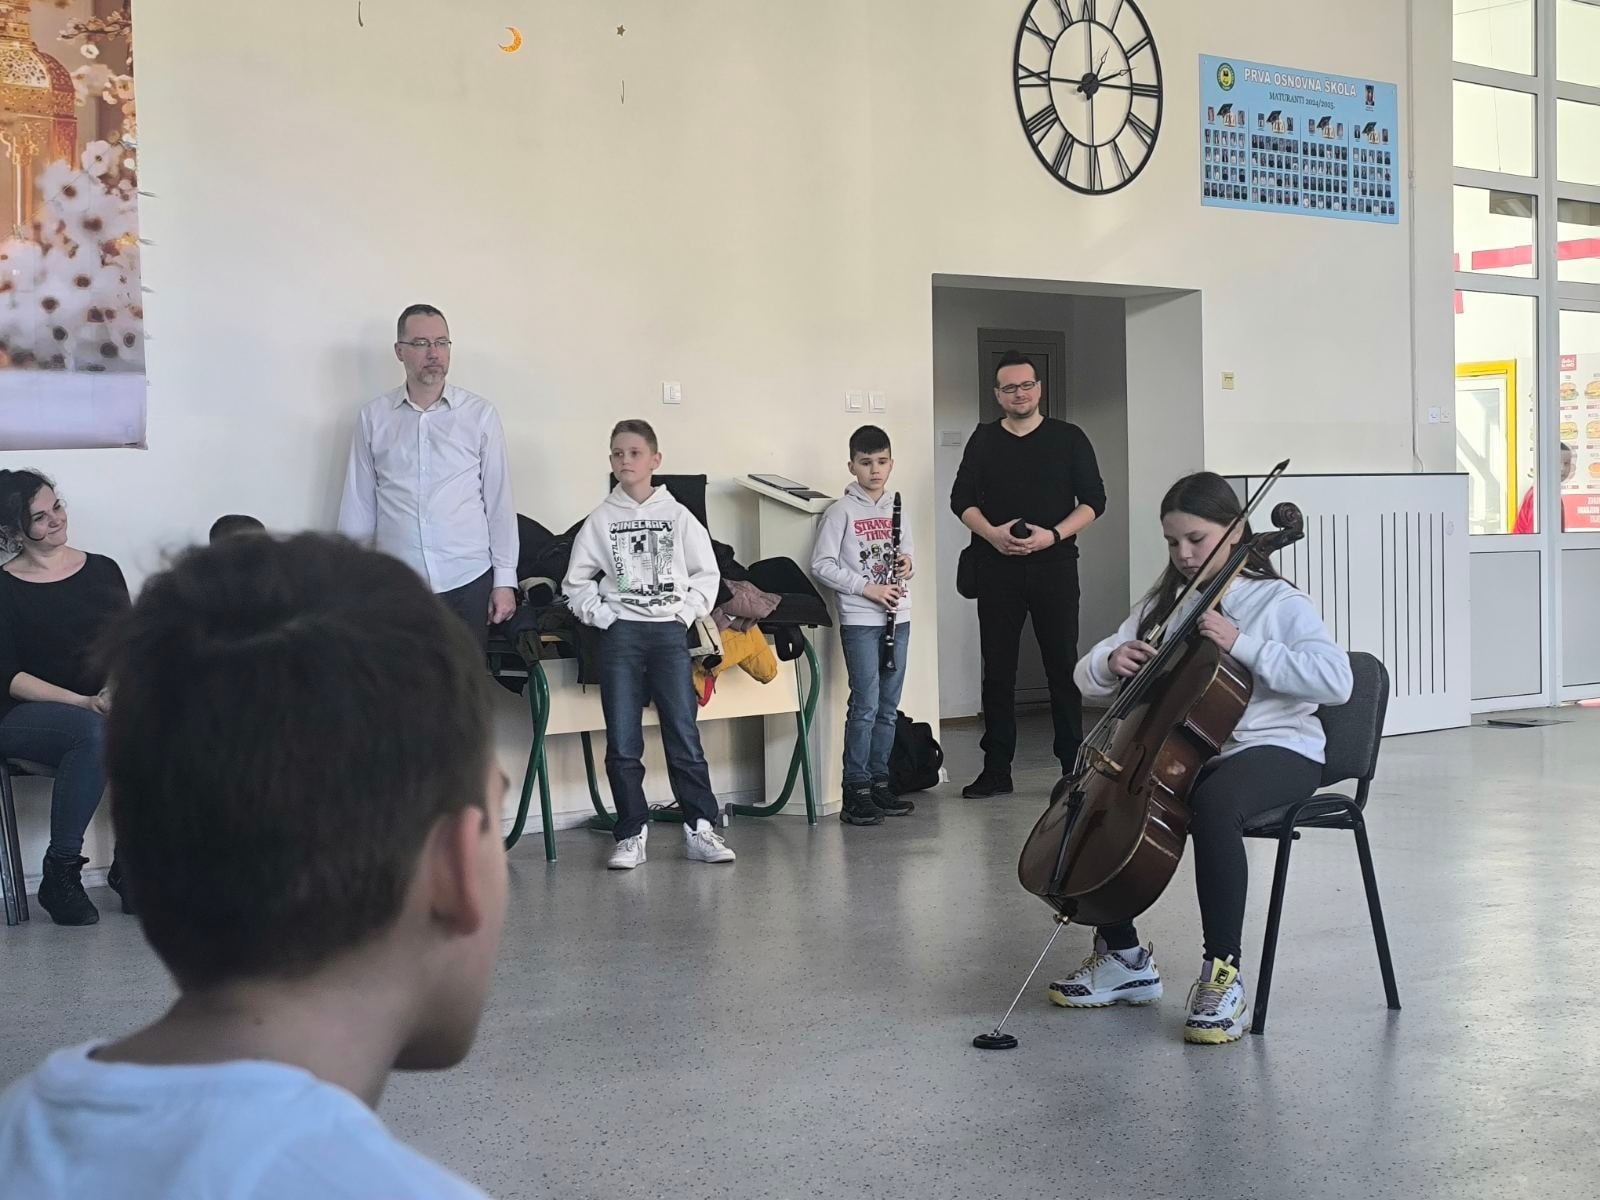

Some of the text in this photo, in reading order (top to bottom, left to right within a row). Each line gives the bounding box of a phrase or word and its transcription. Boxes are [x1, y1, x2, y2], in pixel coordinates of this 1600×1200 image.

[1244, 68, 1271, 84] PRVA
[1274, 72, 1322, 92] OSNOVNA
[1324, 77, 1357, 97] ŠKOLA
[1269, 92, 1304, 104] MATURANTI
[609, 520, 673, 533] MINECRAFT
[854, 518, 894, 534] STRANG
[863, 529, 893, 541] THING
[610, 533, 624, 576] HOSTILE
